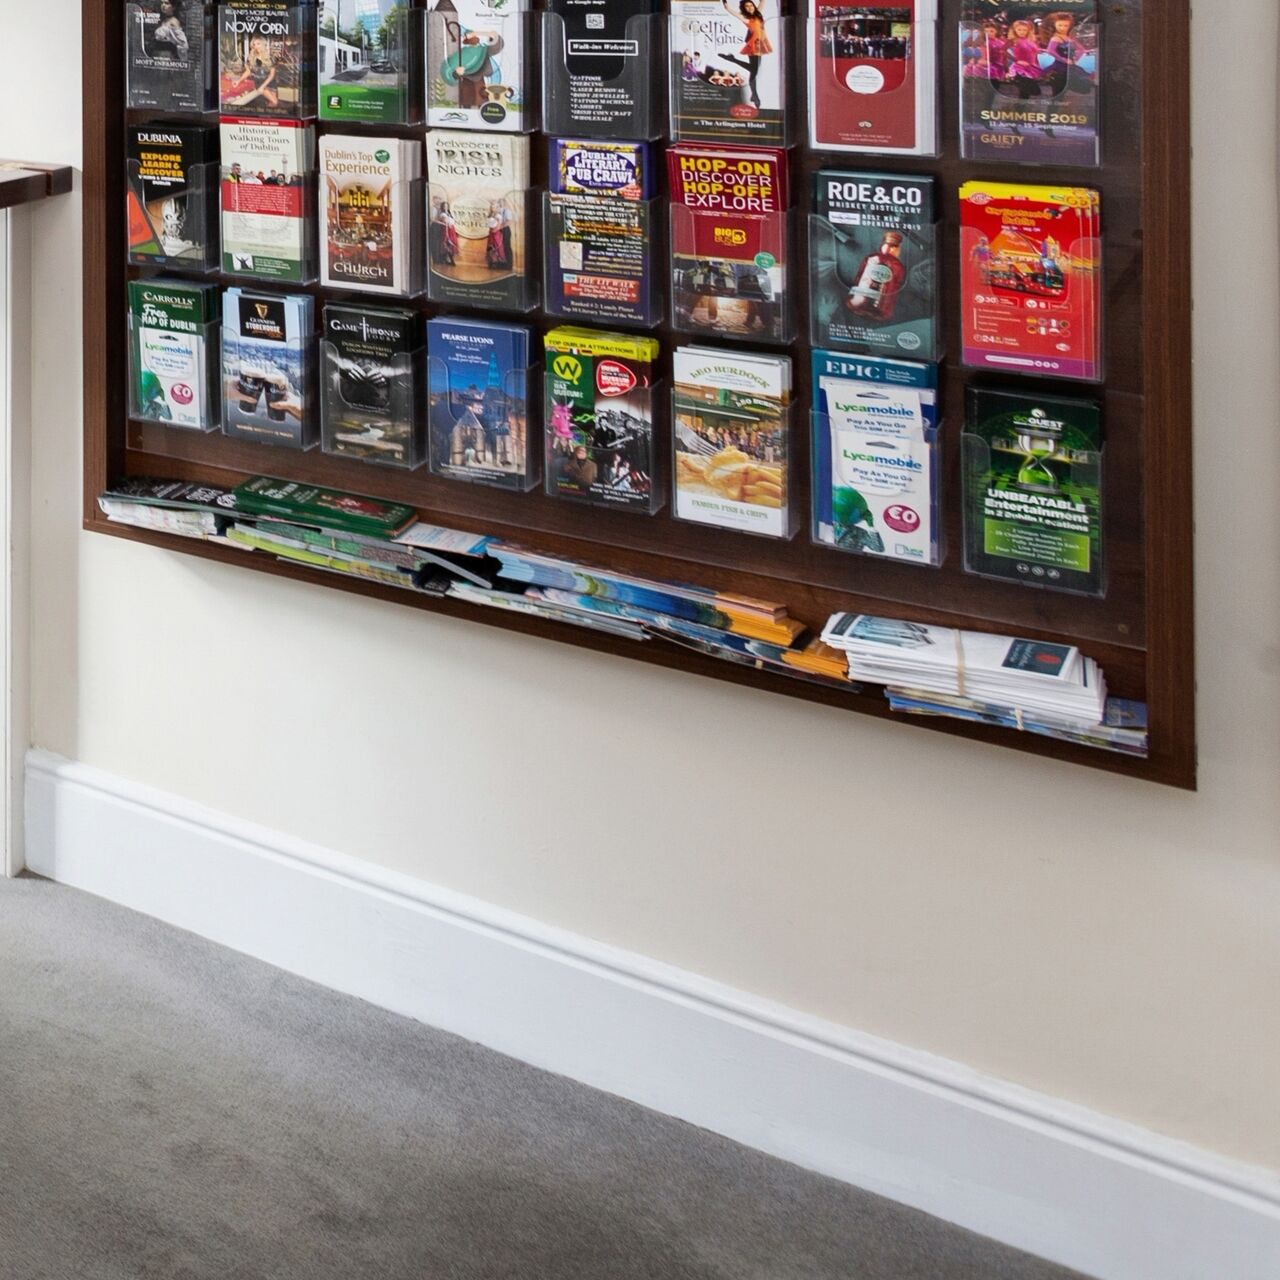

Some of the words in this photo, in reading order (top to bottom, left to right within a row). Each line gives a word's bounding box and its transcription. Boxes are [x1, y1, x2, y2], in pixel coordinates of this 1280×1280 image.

[225, 21, 257, 33] NOW
[259, 23, 288, 35] OPEN
[689, 20, 731, 35] Celtic
[980, 110, 1046, 122] SUMMER
[1049, 112, 1087, 125] 2019
[238, 127, 280, 135] Historical
[230, 134, 265, 144] Walking
[268, 135, 290, 144] Tours
[980, 134, 1024, 146] GAIETY
[240, 143, 248, 151] of
[249, 142, 280, 152] Dublin
[141, 152, 182, 162] EXPLORE
[325, 149, 357, 161] Dublin's
[358, 152, 373, 162] Top
[435, 149, 503, 167] IRISH
[581, 150, 617, 161] DUBLIN
[143, 160, 172, 170] LEARN
[325, 160, 390, 176] Experience
[574, 156, 627, 170] LITERARY
[680, 157, 771, 176] HOP-ON
[140, 168, 184, 178] DISCOVER
[567, 166, 592, 180] PUB
[593, 169, 635, 184] CRAWL
[681, 171, 772, 187] DISCOVER
[683, 182, 772, 198] HOP-OFF
[828, 181, 921, 206] ROE&CO
[684, 193, 774, 212] EXPLORE
[829, 201, 866, 209] WHISKEY
[871, 204, 921, 214] DISTILLERY
[714, 227, 731, 236] BIG
[334, 262, 388, 278] CHURCH
[144, 292, 193, 305] CARROLLS
[170, 320, 197, 332] DUBLIN
[441, 333, 468, 343] PEARSE
[469, 335, 494, 345] LYONS
[826, 360, 881, 379] EPIC
[835, 402, 914, 417] Lycamobile
[843, 450, 922, 470] Lycamobile
[988, 488, 1086, 513] UNBEATABLE
